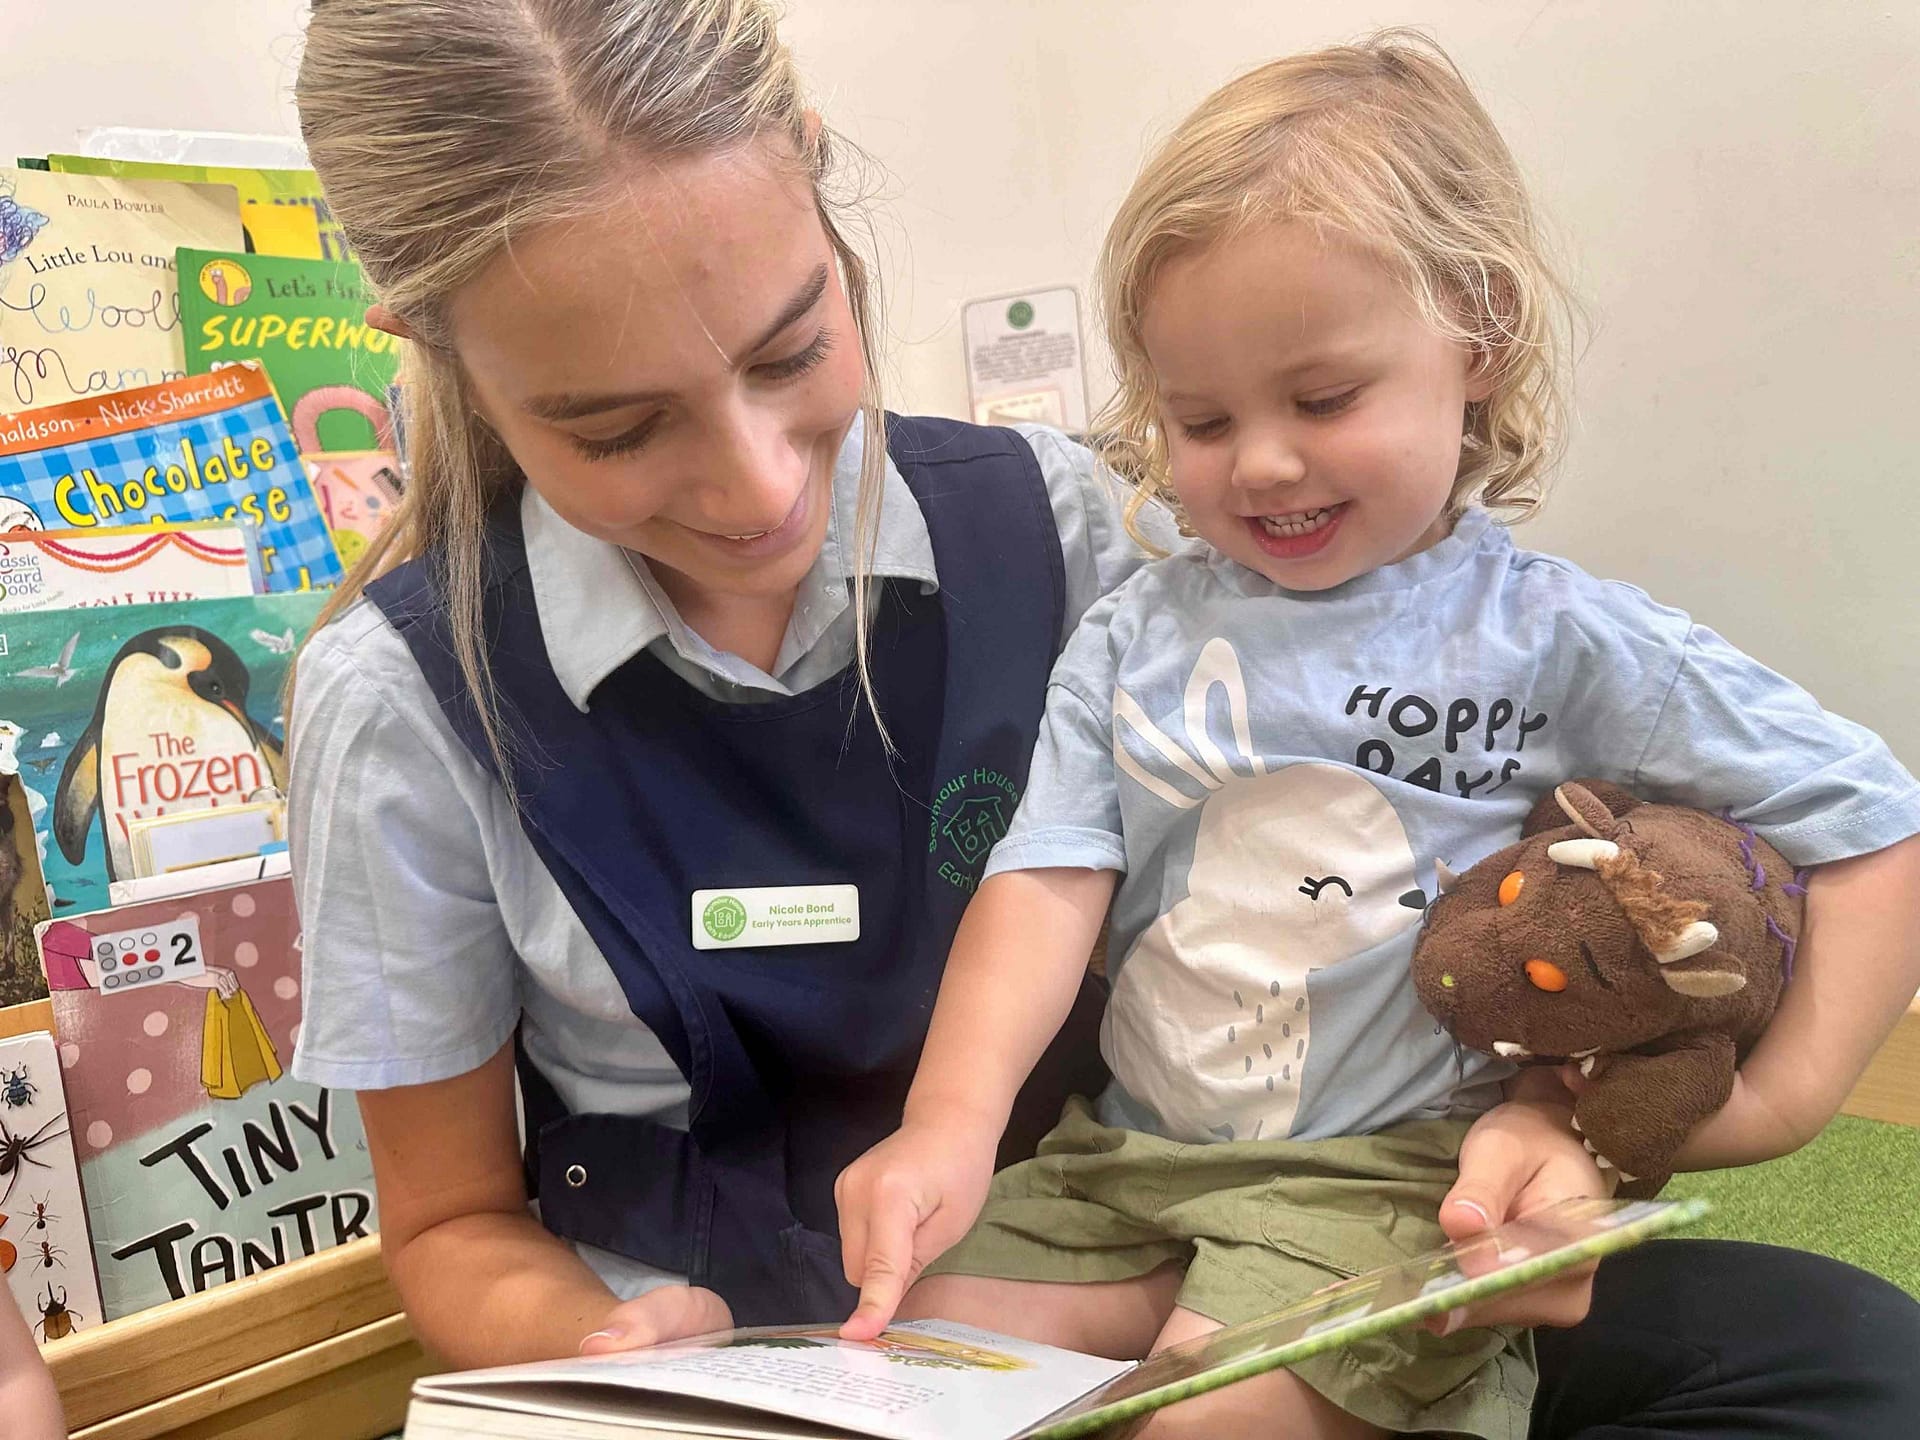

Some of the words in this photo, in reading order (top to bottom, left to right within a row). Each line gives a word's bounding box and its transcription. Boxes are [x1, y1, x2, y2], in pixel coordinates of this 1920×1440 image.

[67, 194, 110, 210] PAULA
[25, 246, 88, 275] Little
[91, 245, 134, 264] Lou
[265, 275, 316, 299] Let's
[98, 399, 152, 428] Nick
[157, 376, 245, 415] Sharratt
[53, 435, 276, 528] Chocolate
[1345, 684, 1549, 753] HOPPY
[148, 731, 196, 758] The
[112, 752, 262, 808] Frozen
[752, 920, 775, 930] Early
[776, 917, 802, 928] Years
[804, 916, 852, 928] Apprentice
[769, 904, 804, 915] Nicole
[806, 903, 835, 914] Bond
[170, 932, 197, 968] 2
[139, 1088, 336, 1211] TINY
